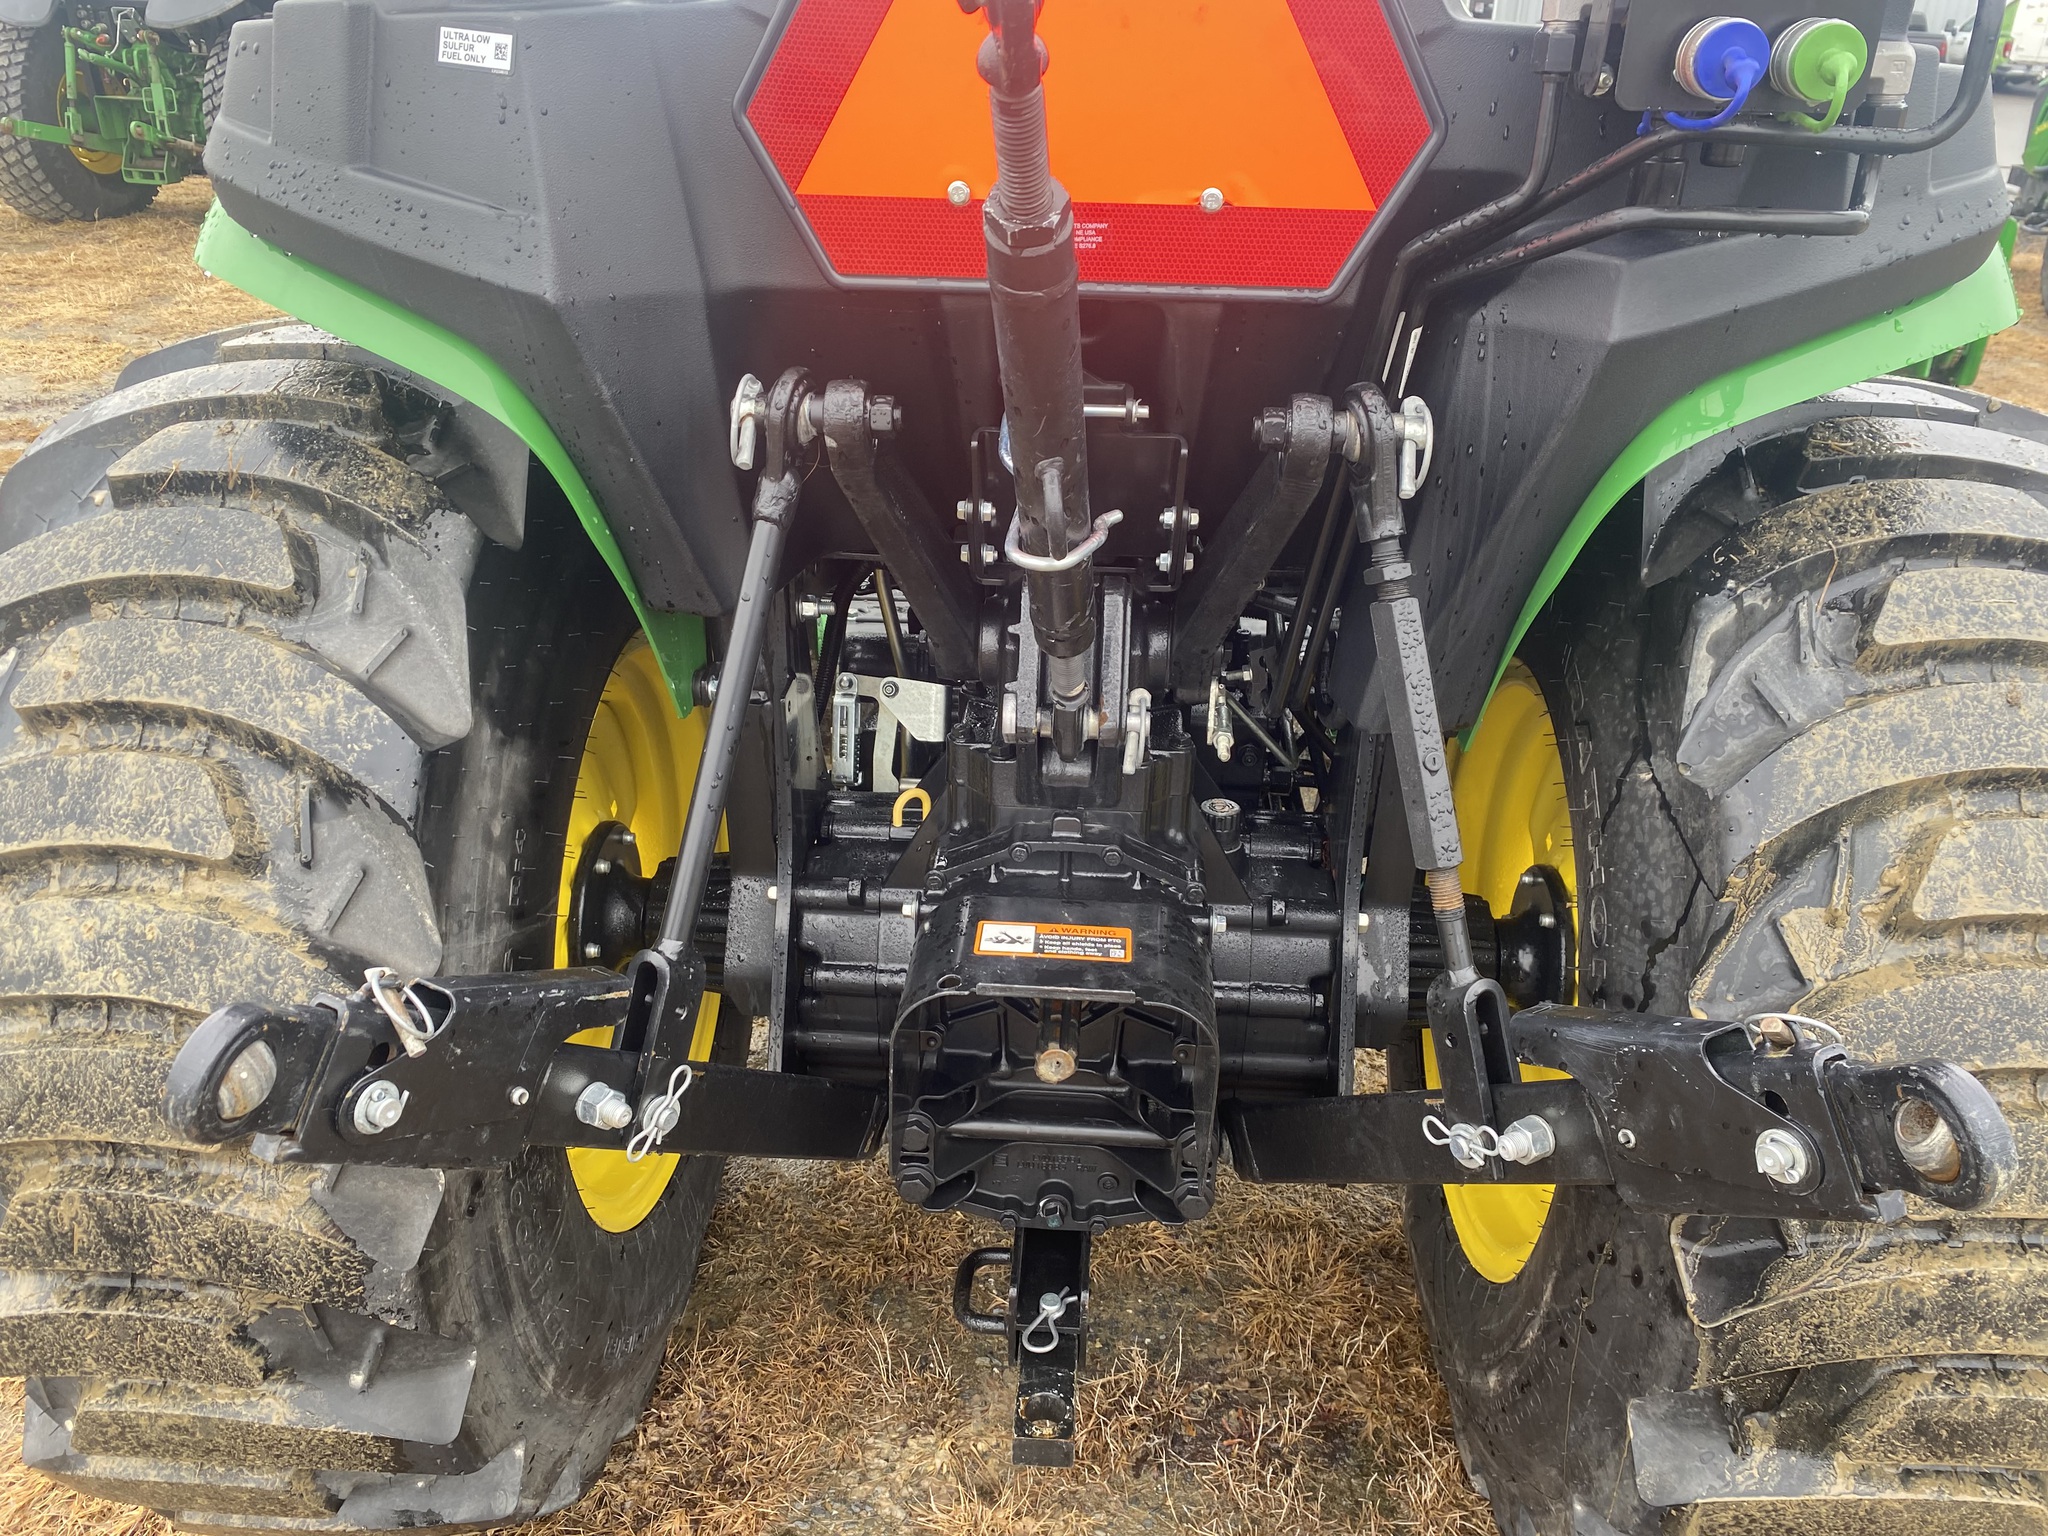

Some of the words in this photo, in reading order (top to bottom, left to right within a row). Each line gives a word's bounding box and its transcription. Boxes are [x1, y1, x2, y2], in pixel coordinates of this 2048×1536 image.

[443, 30, 470, 42] ULTRA
[471, 33, 491, 44] LOW
[443, 40, 475, 52] SULFUR
[441, 50, 462, 61] FUEL
[464, 53, 487, 63] ONLY
[1061, 927, 1117, 936] WARNING
